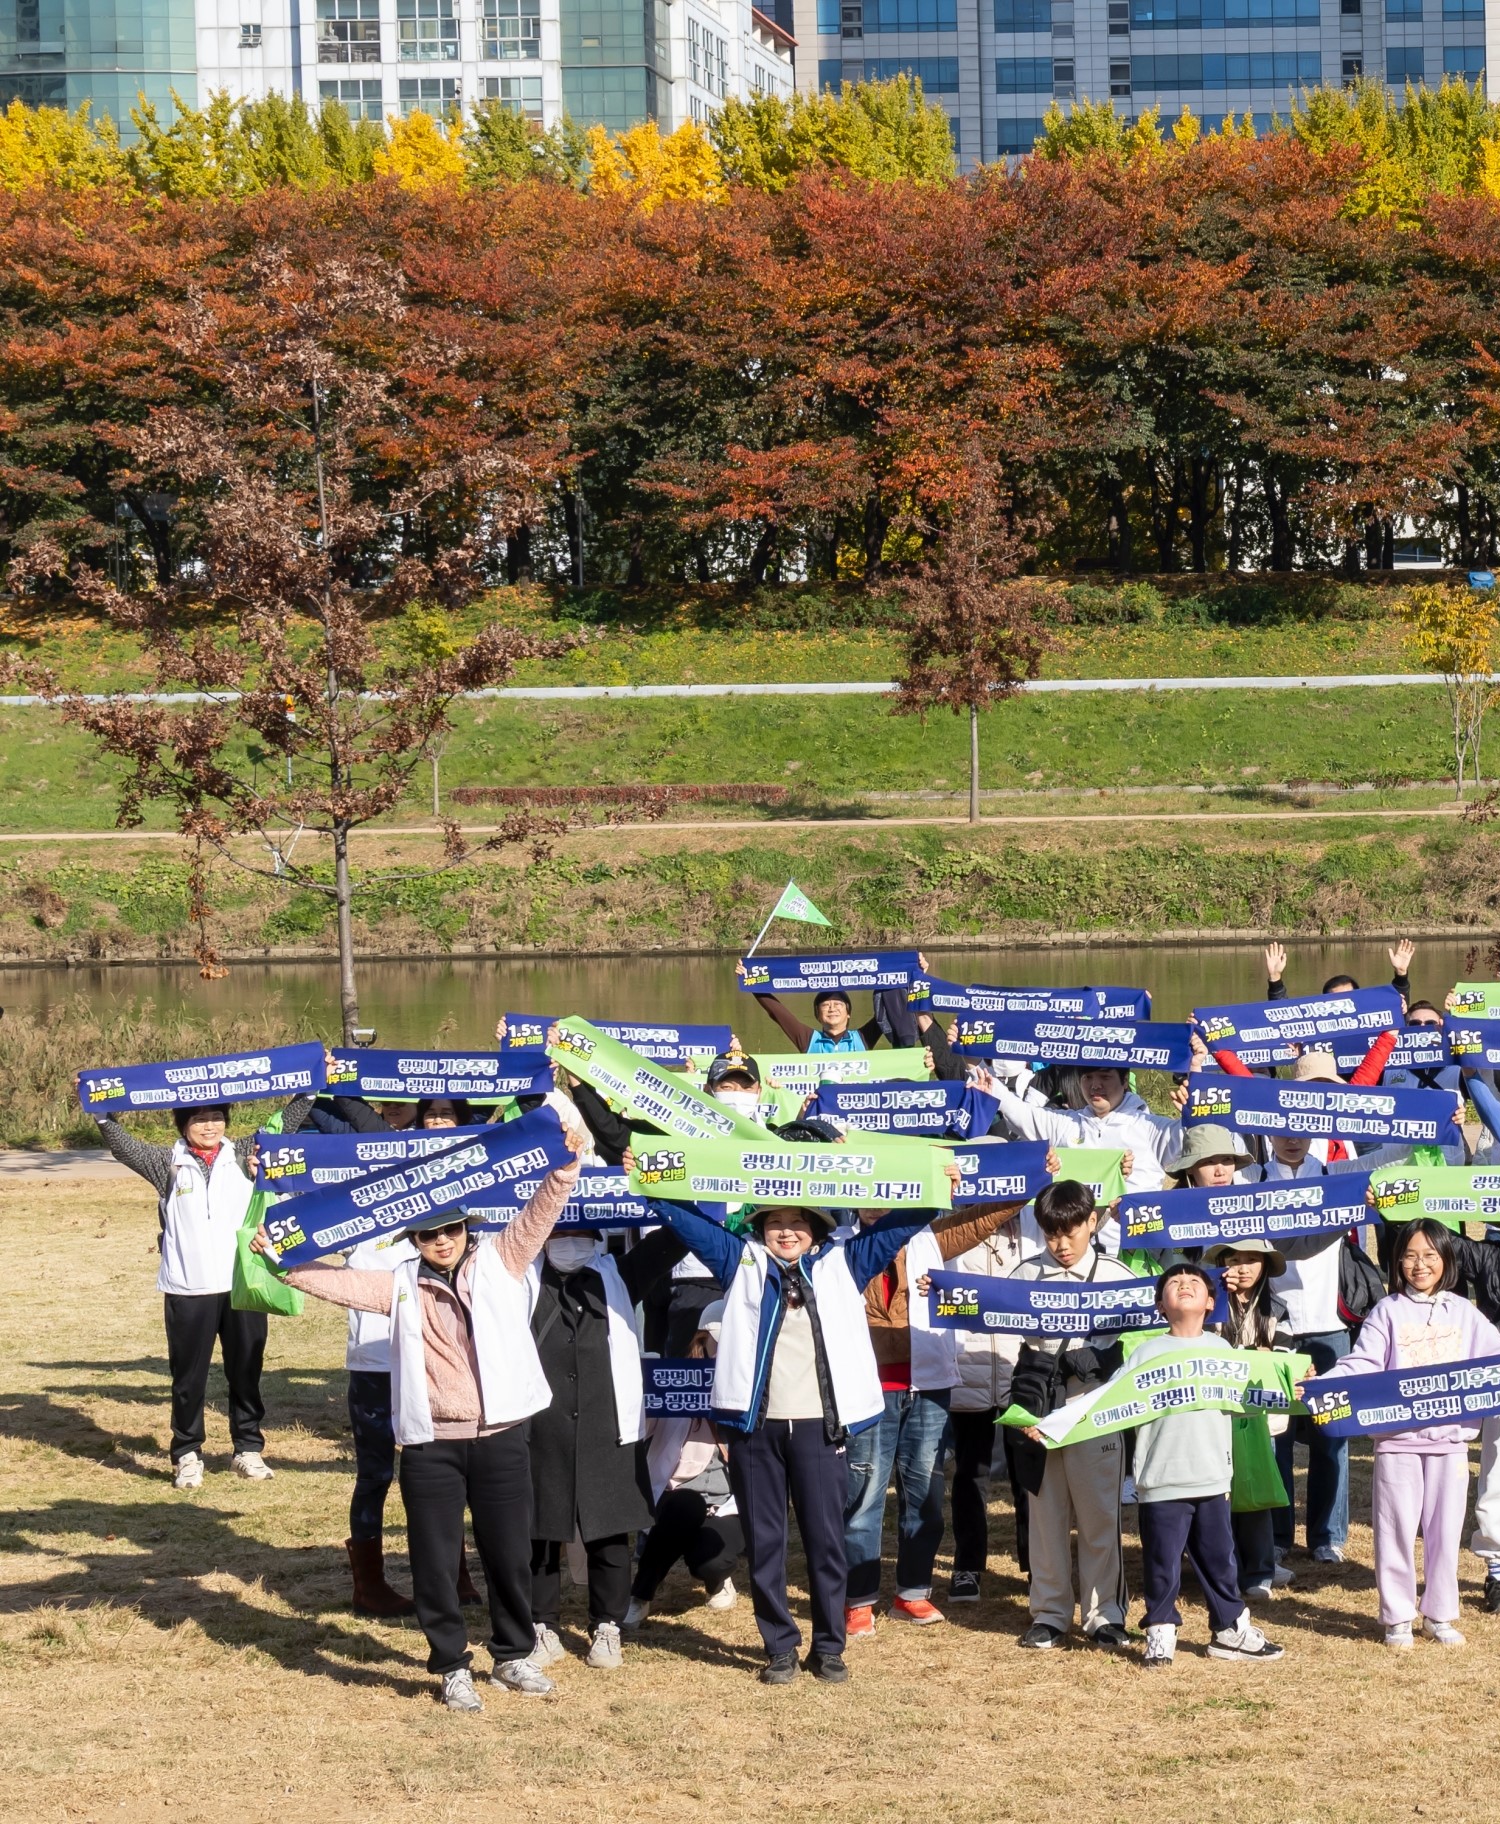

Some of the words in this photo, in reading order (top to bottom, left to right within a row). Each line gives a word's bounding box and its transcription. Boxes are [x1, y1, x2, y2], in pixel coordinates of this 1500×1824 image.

[1035, 1023, 1075, 1039] 광명시
[1075, 1026, 1136, 1043] 기후주간
[996, 1040, 1038, 1055] 함께하는
[1040, 1043, 1079, 1059] 광명!!
[1082, 1046, 1102, 1059] 함께
[1104, 1048, 1127, 1060] 사는
[1128, 1048, 1169, 1064] 지구!!
[165, 1066, 208, 1082] 광명시
[209, 1057, 271, 1077] 기후주간
[130, 1090, 176, 1104] 함께하는
[178, 1083, 218, 1100] 광명!!
[221, 1082, 245, 1095] 함께
[246, 1079, 269, 1092] 사는
[272, 1071, 311, 1090] 지구!!
[1279, 1090, 1324, 1109] 광명시
[1326, 1092, 1395, 1115] 기후주간
[1236, 1110, 1286, 1128] 함께하는
[1288, 1113, 1333, 1132] 광명!!
[1336, 1116, 1362, 1133] 함께
[1363, 1120, 1389, 1136] 사는
[1391, 1119, 1436, 1138] 지구!!
[351, 1174, 406, 1207] 광명시
[406, 1143, 488, 1187] 기후주간
[741, 1153, 792, 1171] 광명시
[796, 1153, 874, 1175] 기후주간
[313, 1215, 375, 1247] 함께하는
[374, 1194, 431, 1224] 광명!!
[430, 1180, 461, 1204] 함께
[461, 1171, 493, 1194] 사는
[494, 1148, 549, 1182] 지구!!
[691, 1176, 747, 1192] 함께하는
[752, 1177, 802, 1198] 광명!!
[809, 1181, 836, 1196] 함께
[839, 1182, 867, 1198] 사는
[872, 1181, 921, 1200] 지구!!
[1209, 1195, 1254, 1215] 광명시
[1256, 1190, 1323, 1210] 기후주간
[1424, 1198, 1477, 1213] 함께하는
[1169, 1222, 1218, 1240] 함께하는
[1219, 1216, 1264, 1237] 광명!!
[1267, 1214, 1293, 1231] 함께
[1294, 1210, 1320, 1226] 사는
[1321, 1205, 1366, 1225] 지구!!
[1399, 1374, 1448, 1397] 광명시
[1357, 1405, 1412, 1426] 함께하는
[1412, 1395, 1461, 1420] 광명!!
[1465, 1394, 1492, 1411] 함께
[1100, 1442, 1117, 1454] YALE
